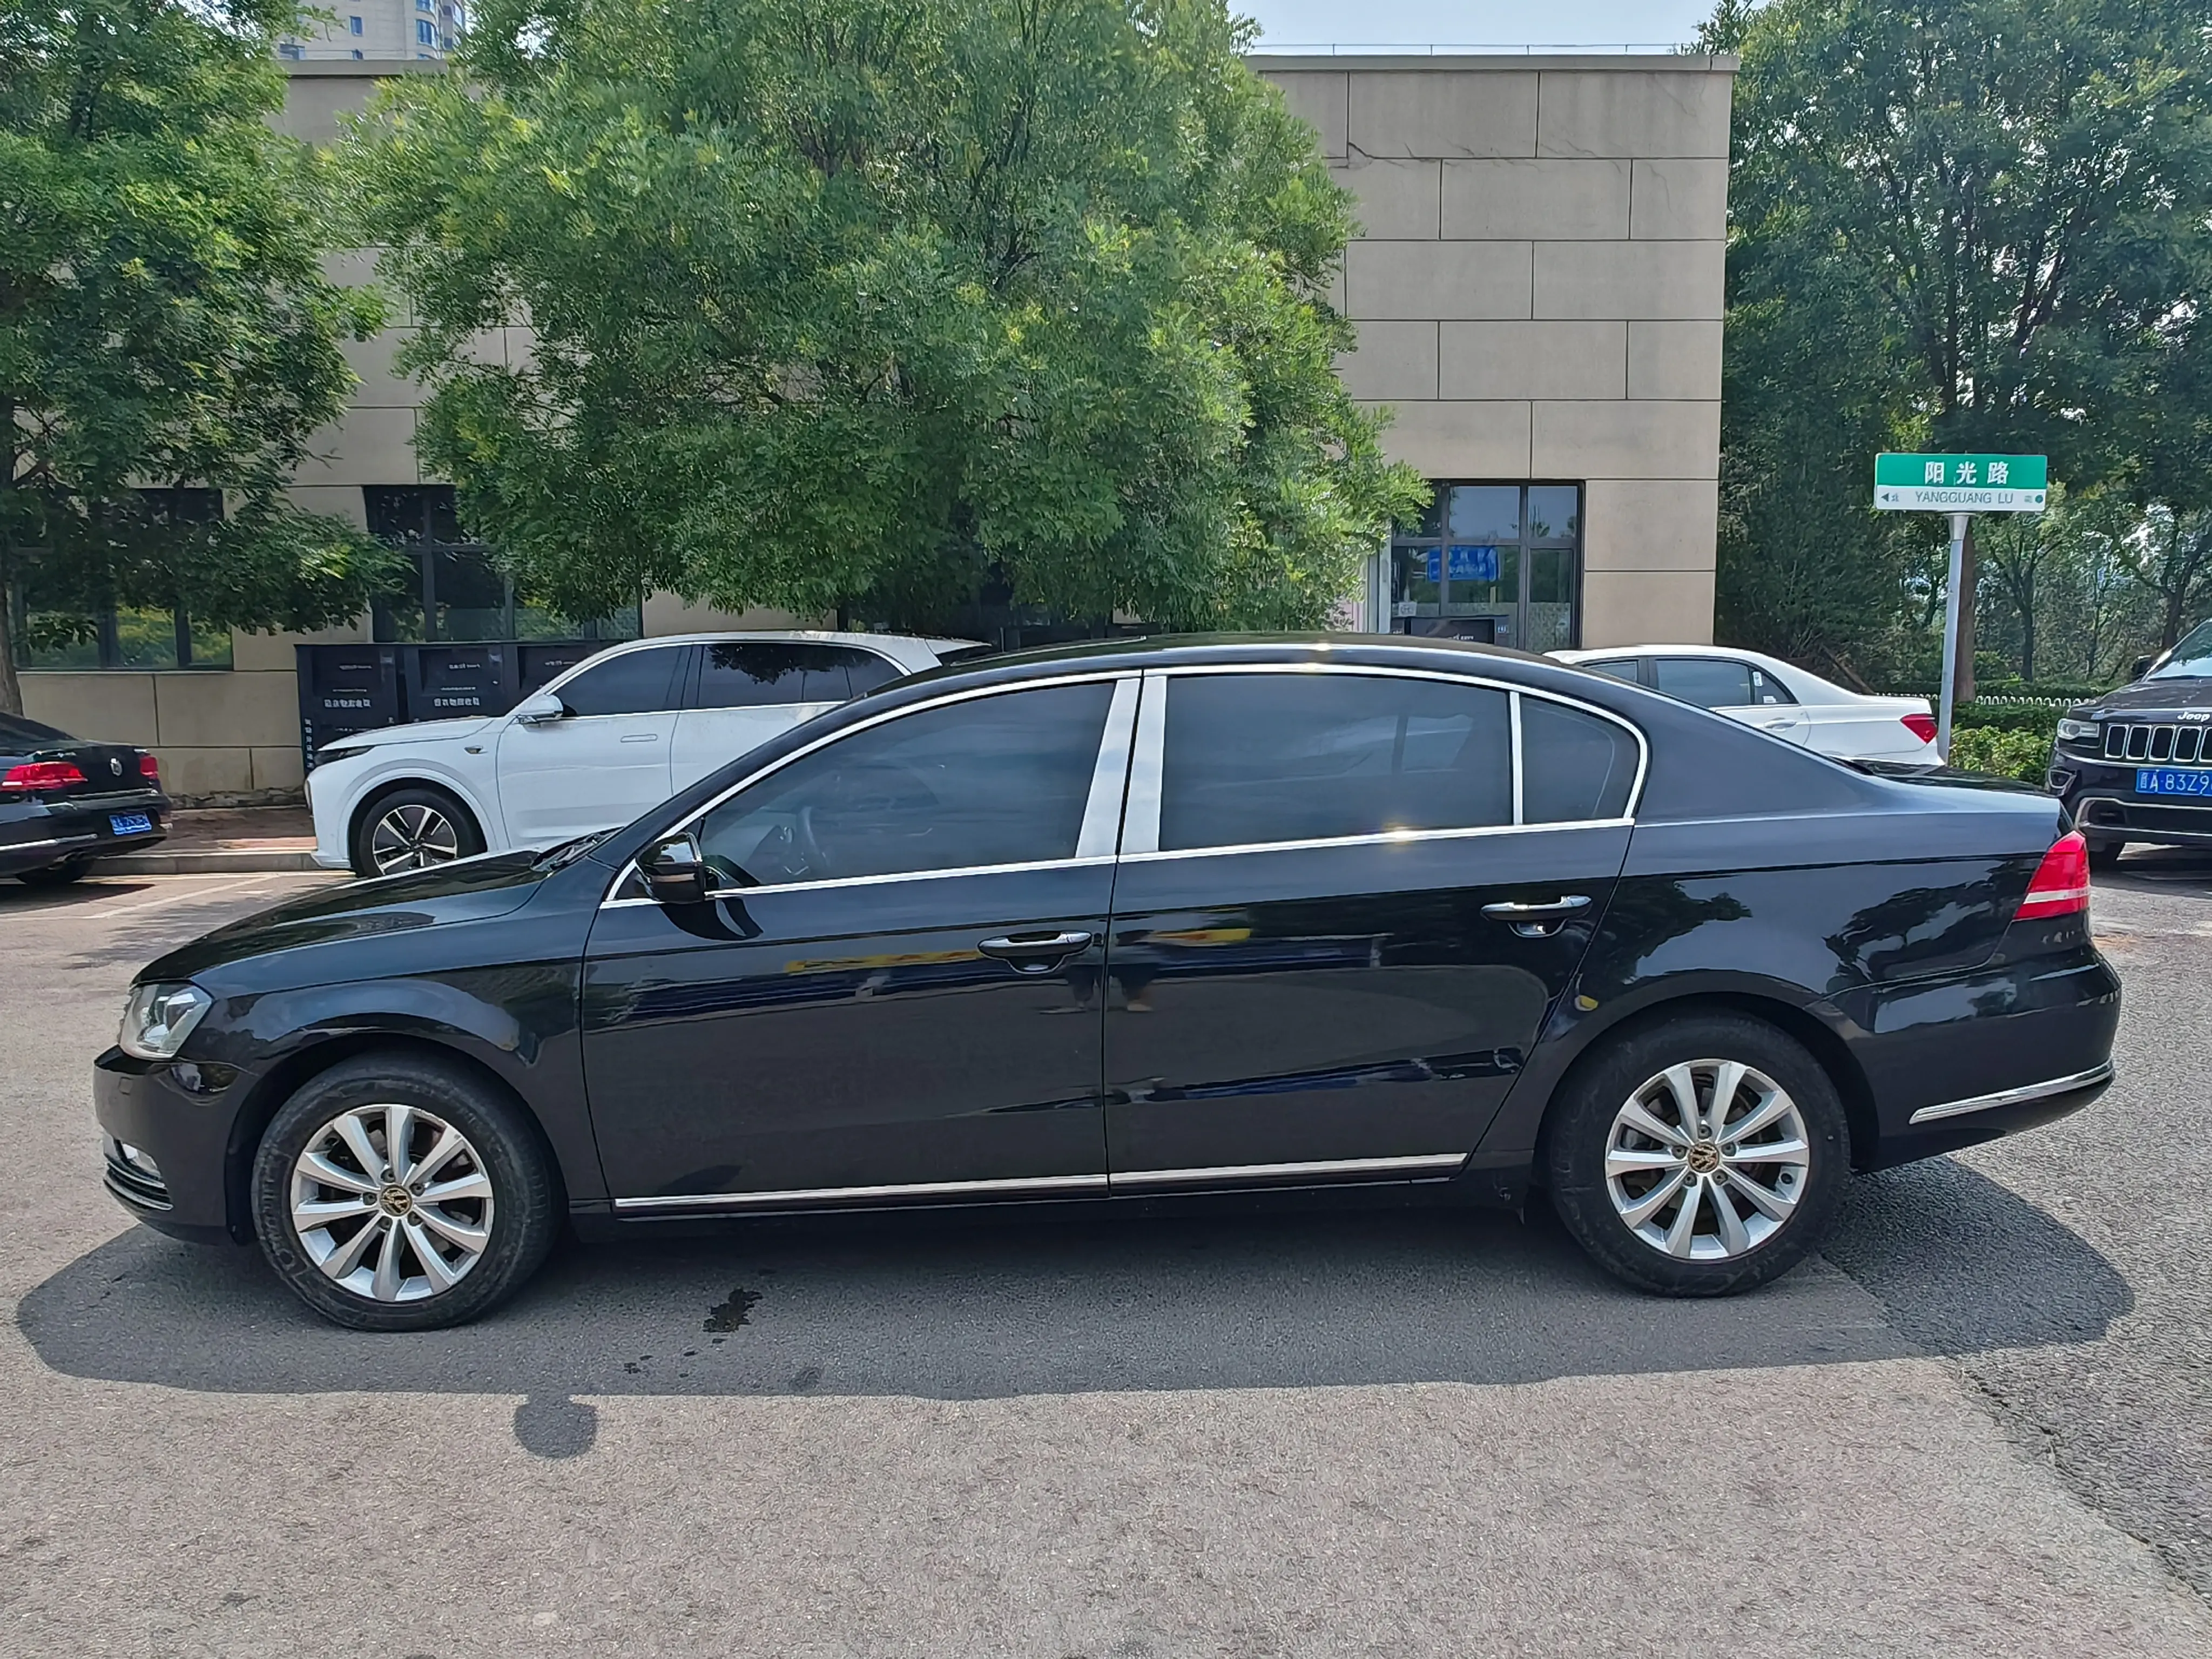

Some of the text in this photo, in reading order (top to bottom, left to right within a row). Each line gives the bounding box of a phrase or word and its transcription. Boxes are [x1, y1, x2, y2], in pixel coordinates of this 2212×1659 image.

[1924, 461, 2009, 485] 阳光路
[1915, 491, 1992, 504] YANGGUANG
[1998, 493, 2014, 504] LU
[2177, 711, 2210, 722] Jeep
